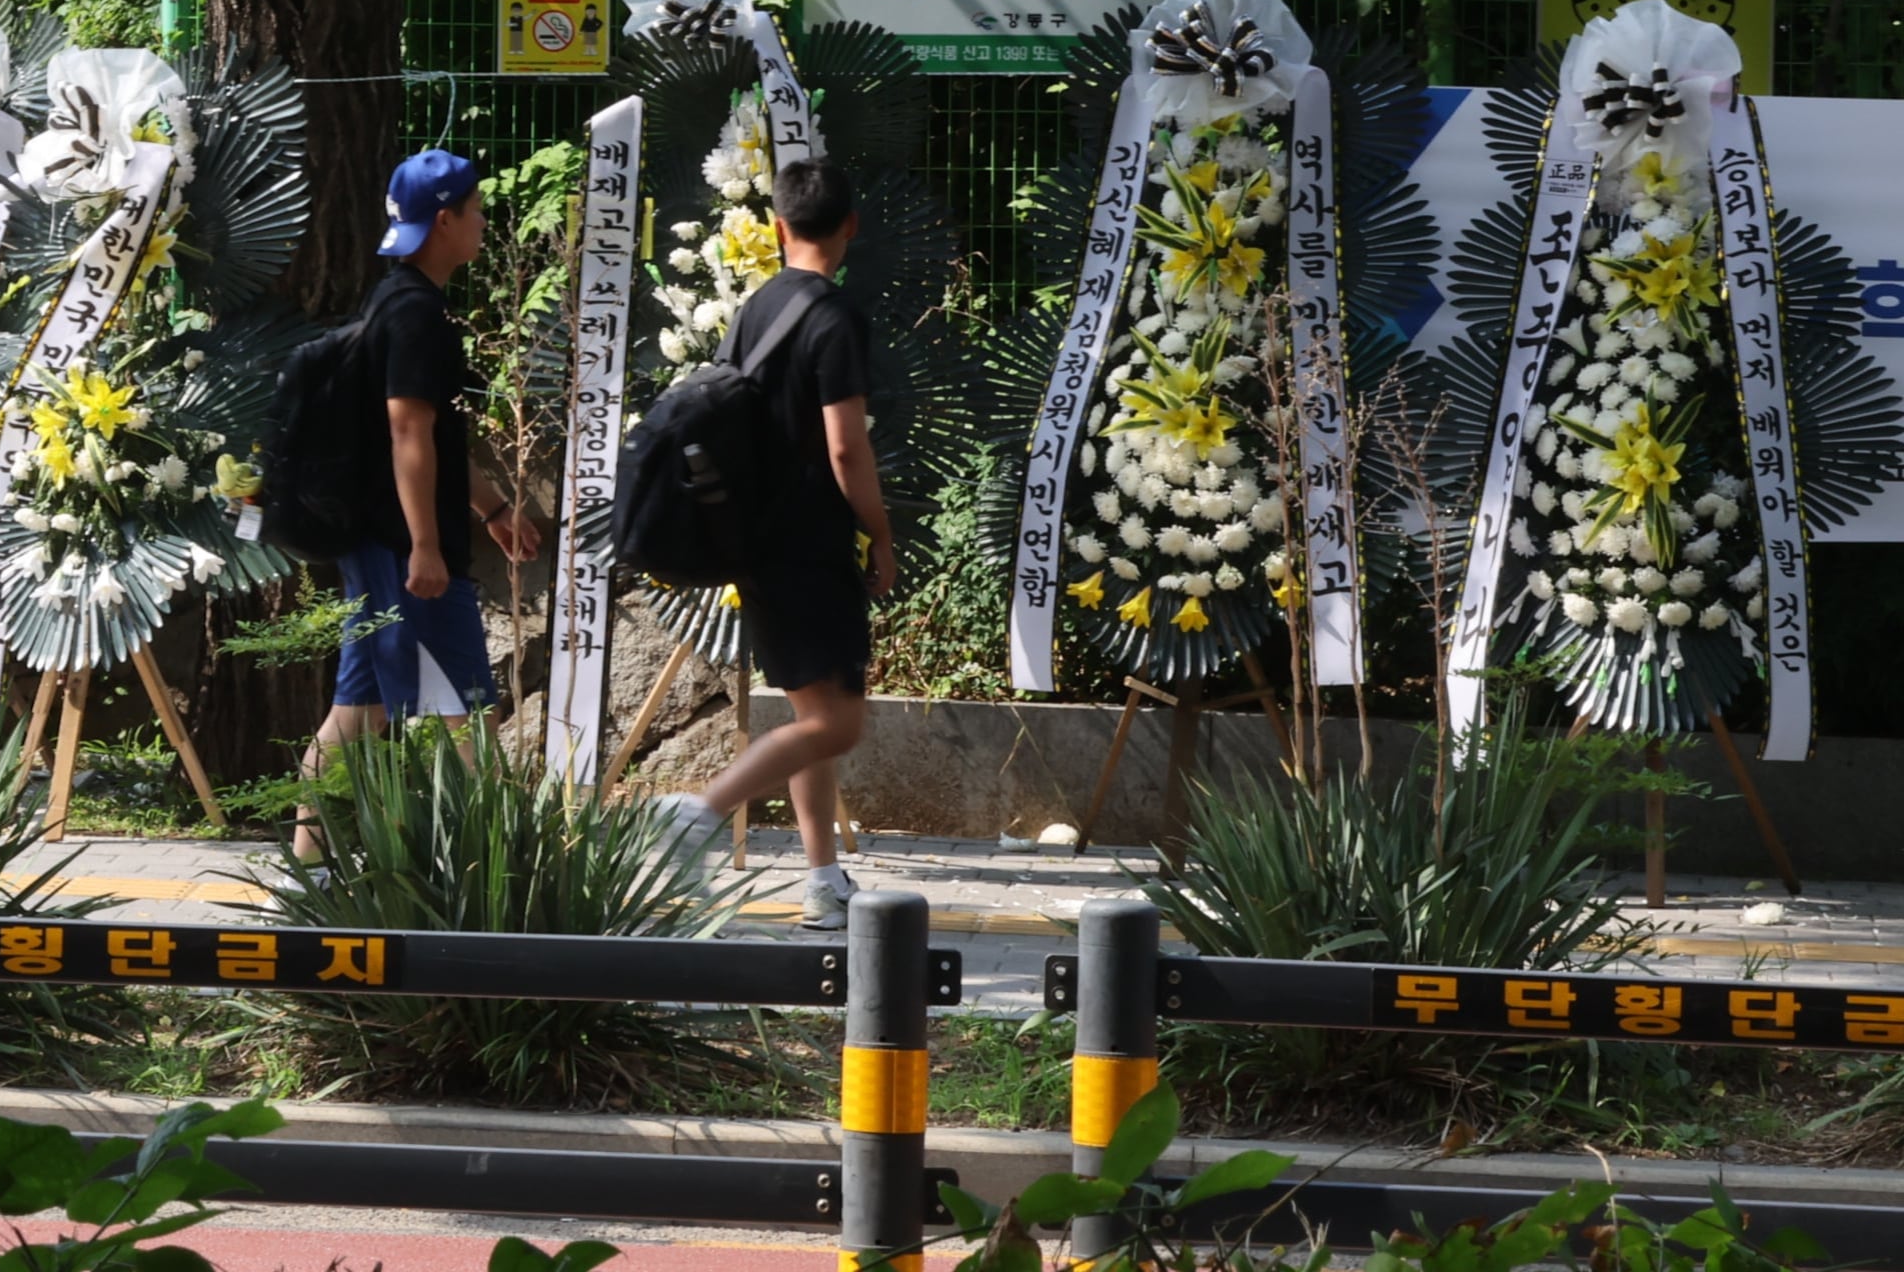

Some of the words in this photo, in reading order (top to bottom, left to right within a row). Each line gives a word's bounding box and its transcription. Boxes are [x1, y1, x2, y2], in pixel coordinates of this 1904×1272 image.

[963, 45, 991, 62] 신고
[1032, 45, 1060, 62] 또는
[1004, 13, 1067, 28] 강동구
[64, 195, 148, 333] 대한민국
[1290, 135, 1335, 278] 역사를
[1716, 148, 1776, 297] 승리보다
[1739, 313, 1777, 390] 먼저
[1307, 455, 1354, 597] 배재고
[1747, 406, 1798, 525] 배워야
